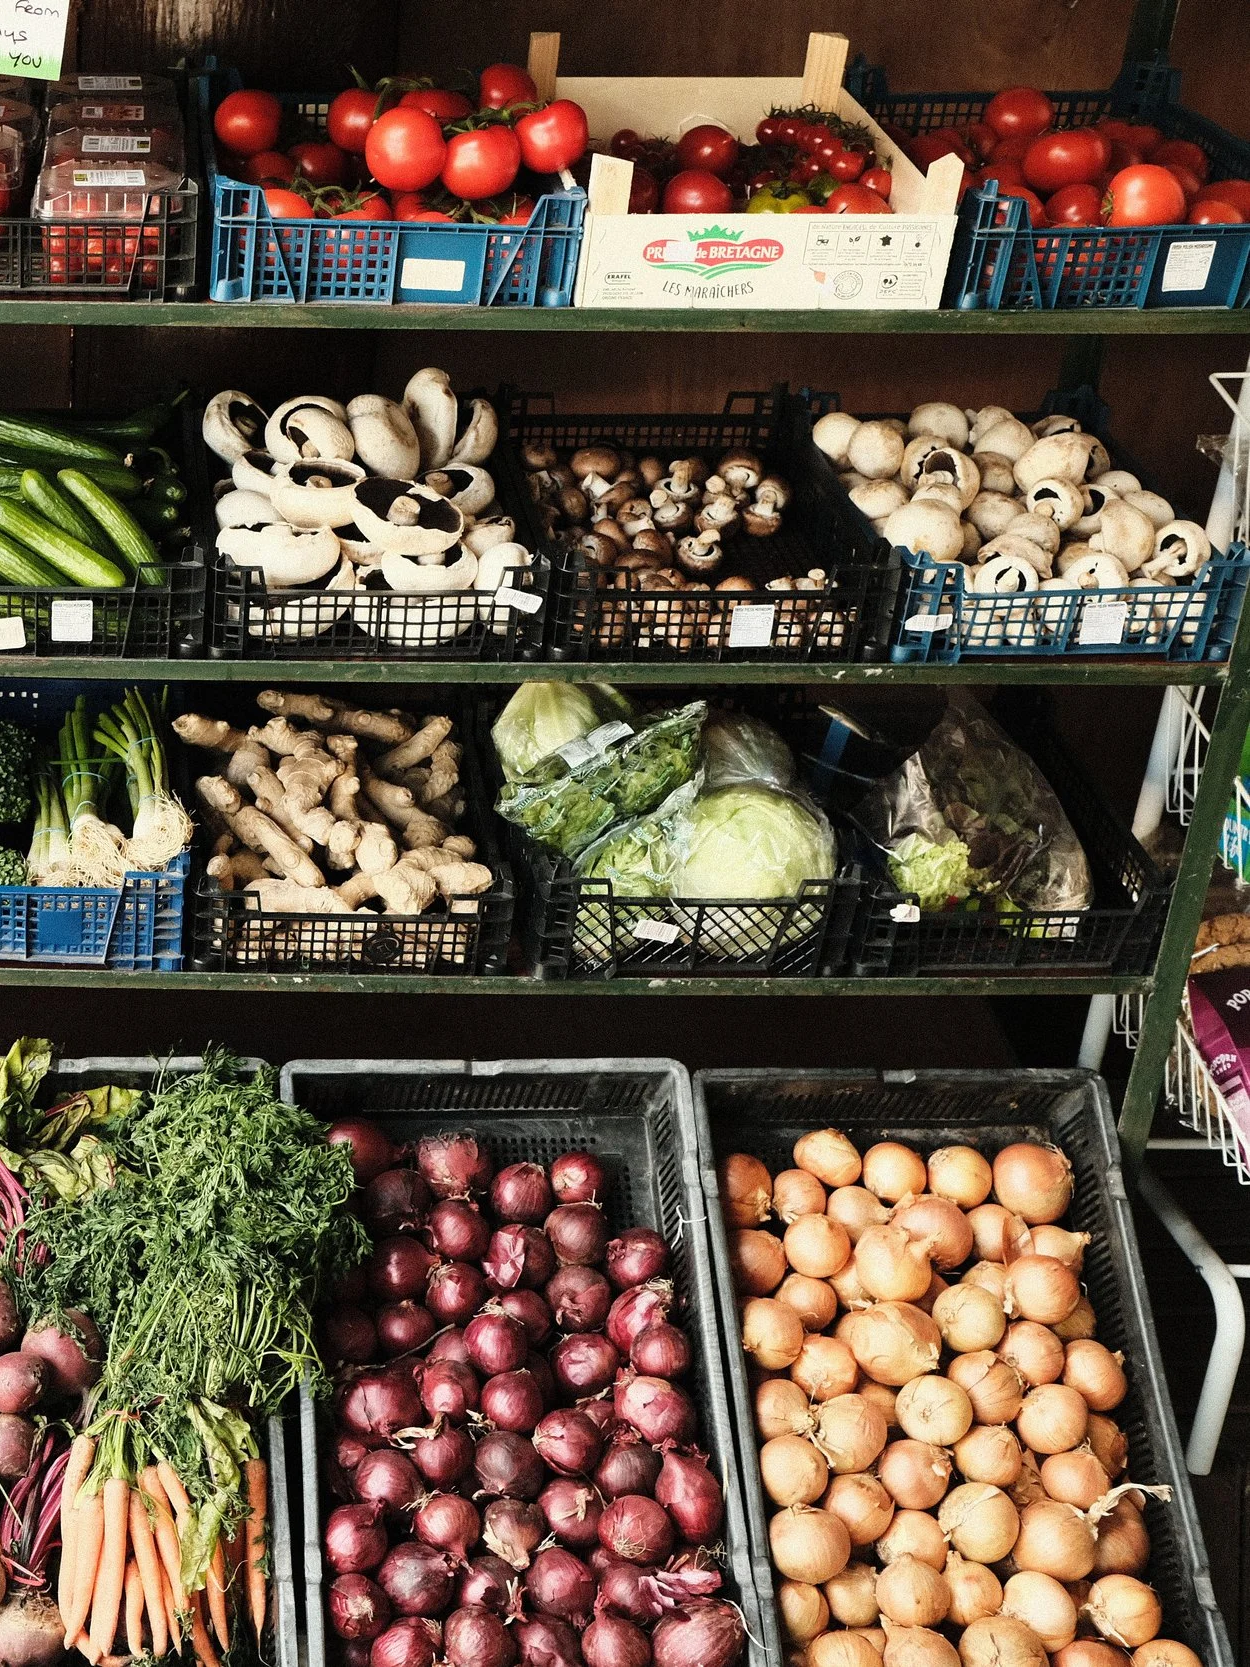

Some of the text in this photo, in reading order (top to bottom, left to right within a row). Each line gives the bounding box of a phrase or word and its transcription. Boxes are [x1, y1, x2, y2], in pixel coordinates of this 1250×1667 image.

[8, 52, 42, 69] YOU
[709, 245, 780, 260] BRETAGNE
[662, 280, 682, 297] LES
[684, 280, 755, 299] MARAÎCHERS
